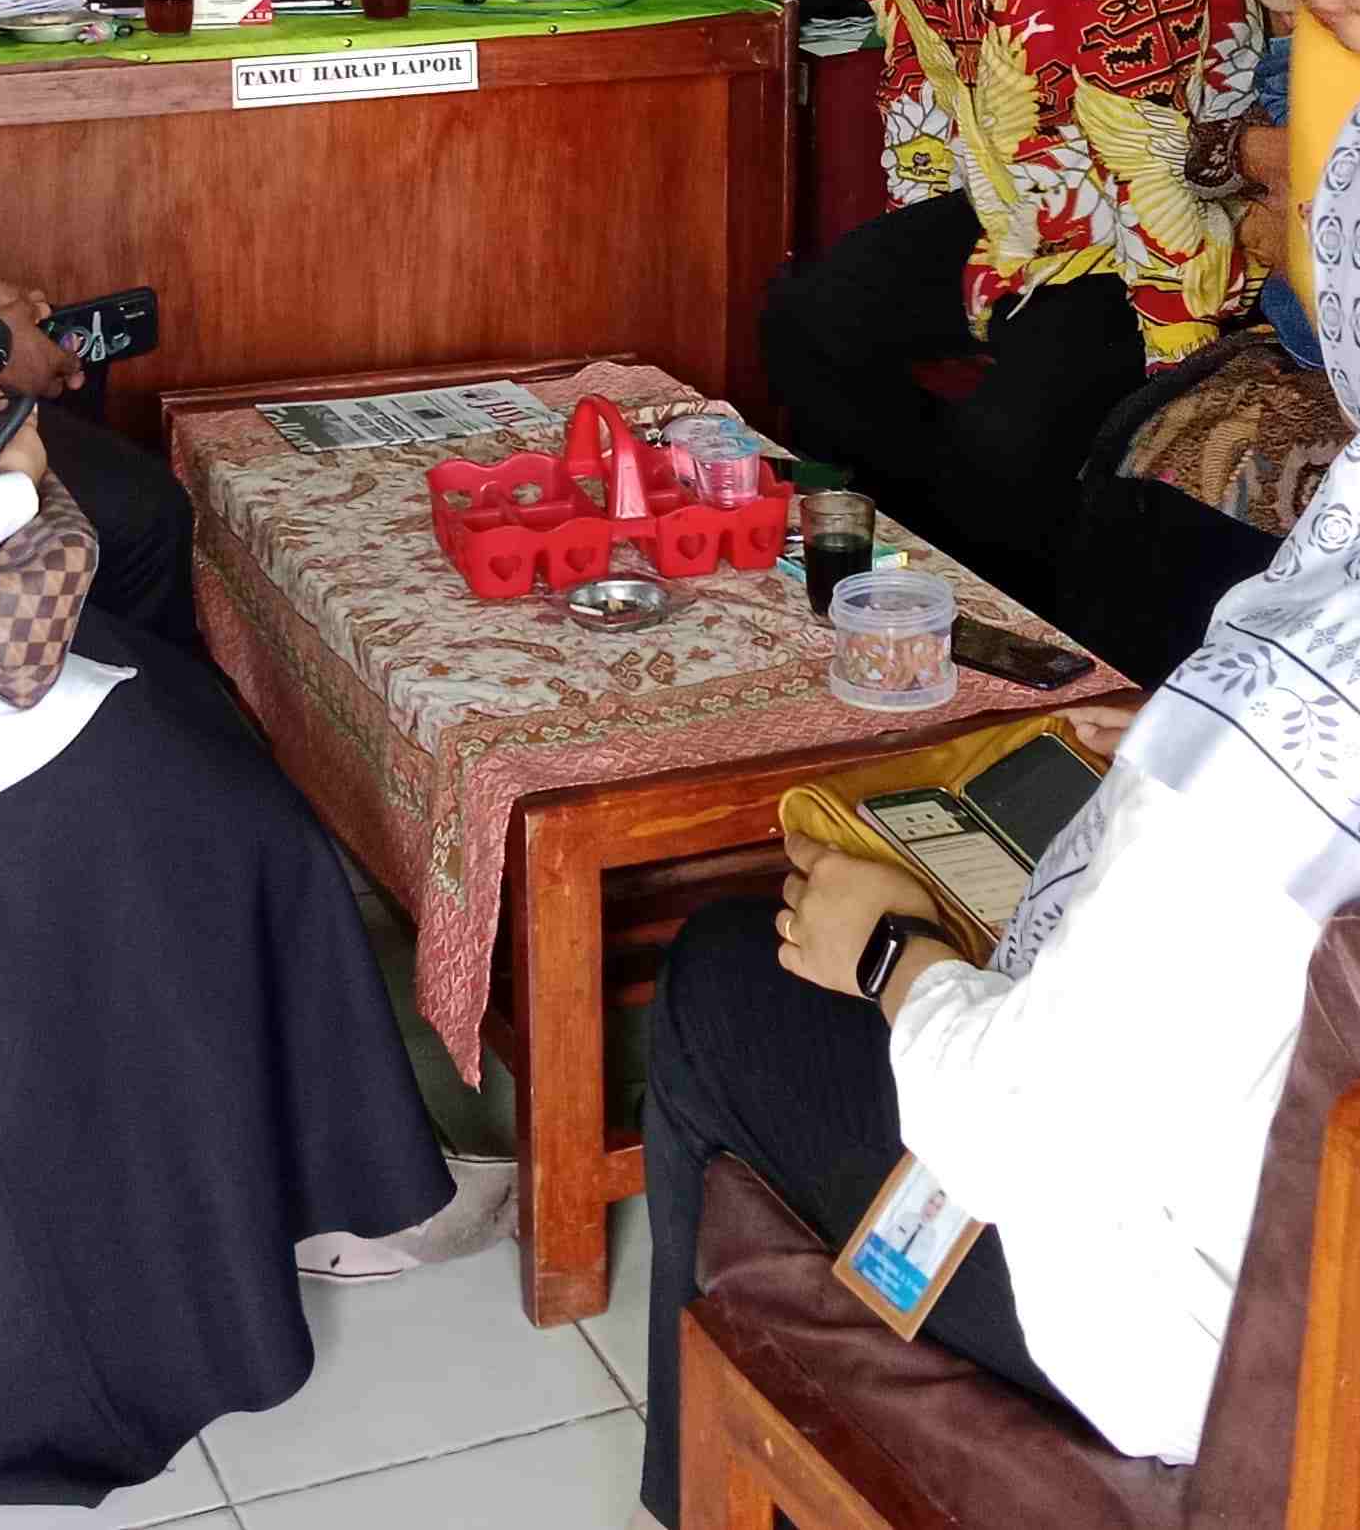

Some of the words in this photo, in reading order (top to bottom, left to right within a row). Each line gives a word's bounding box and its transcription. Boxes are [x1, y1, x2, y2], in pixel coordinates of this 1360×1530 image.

[240, 68, 302, 87] TAMU
[313, 62, 387, 82] HARAP
[392, 56, 463, 76] LAPOR
